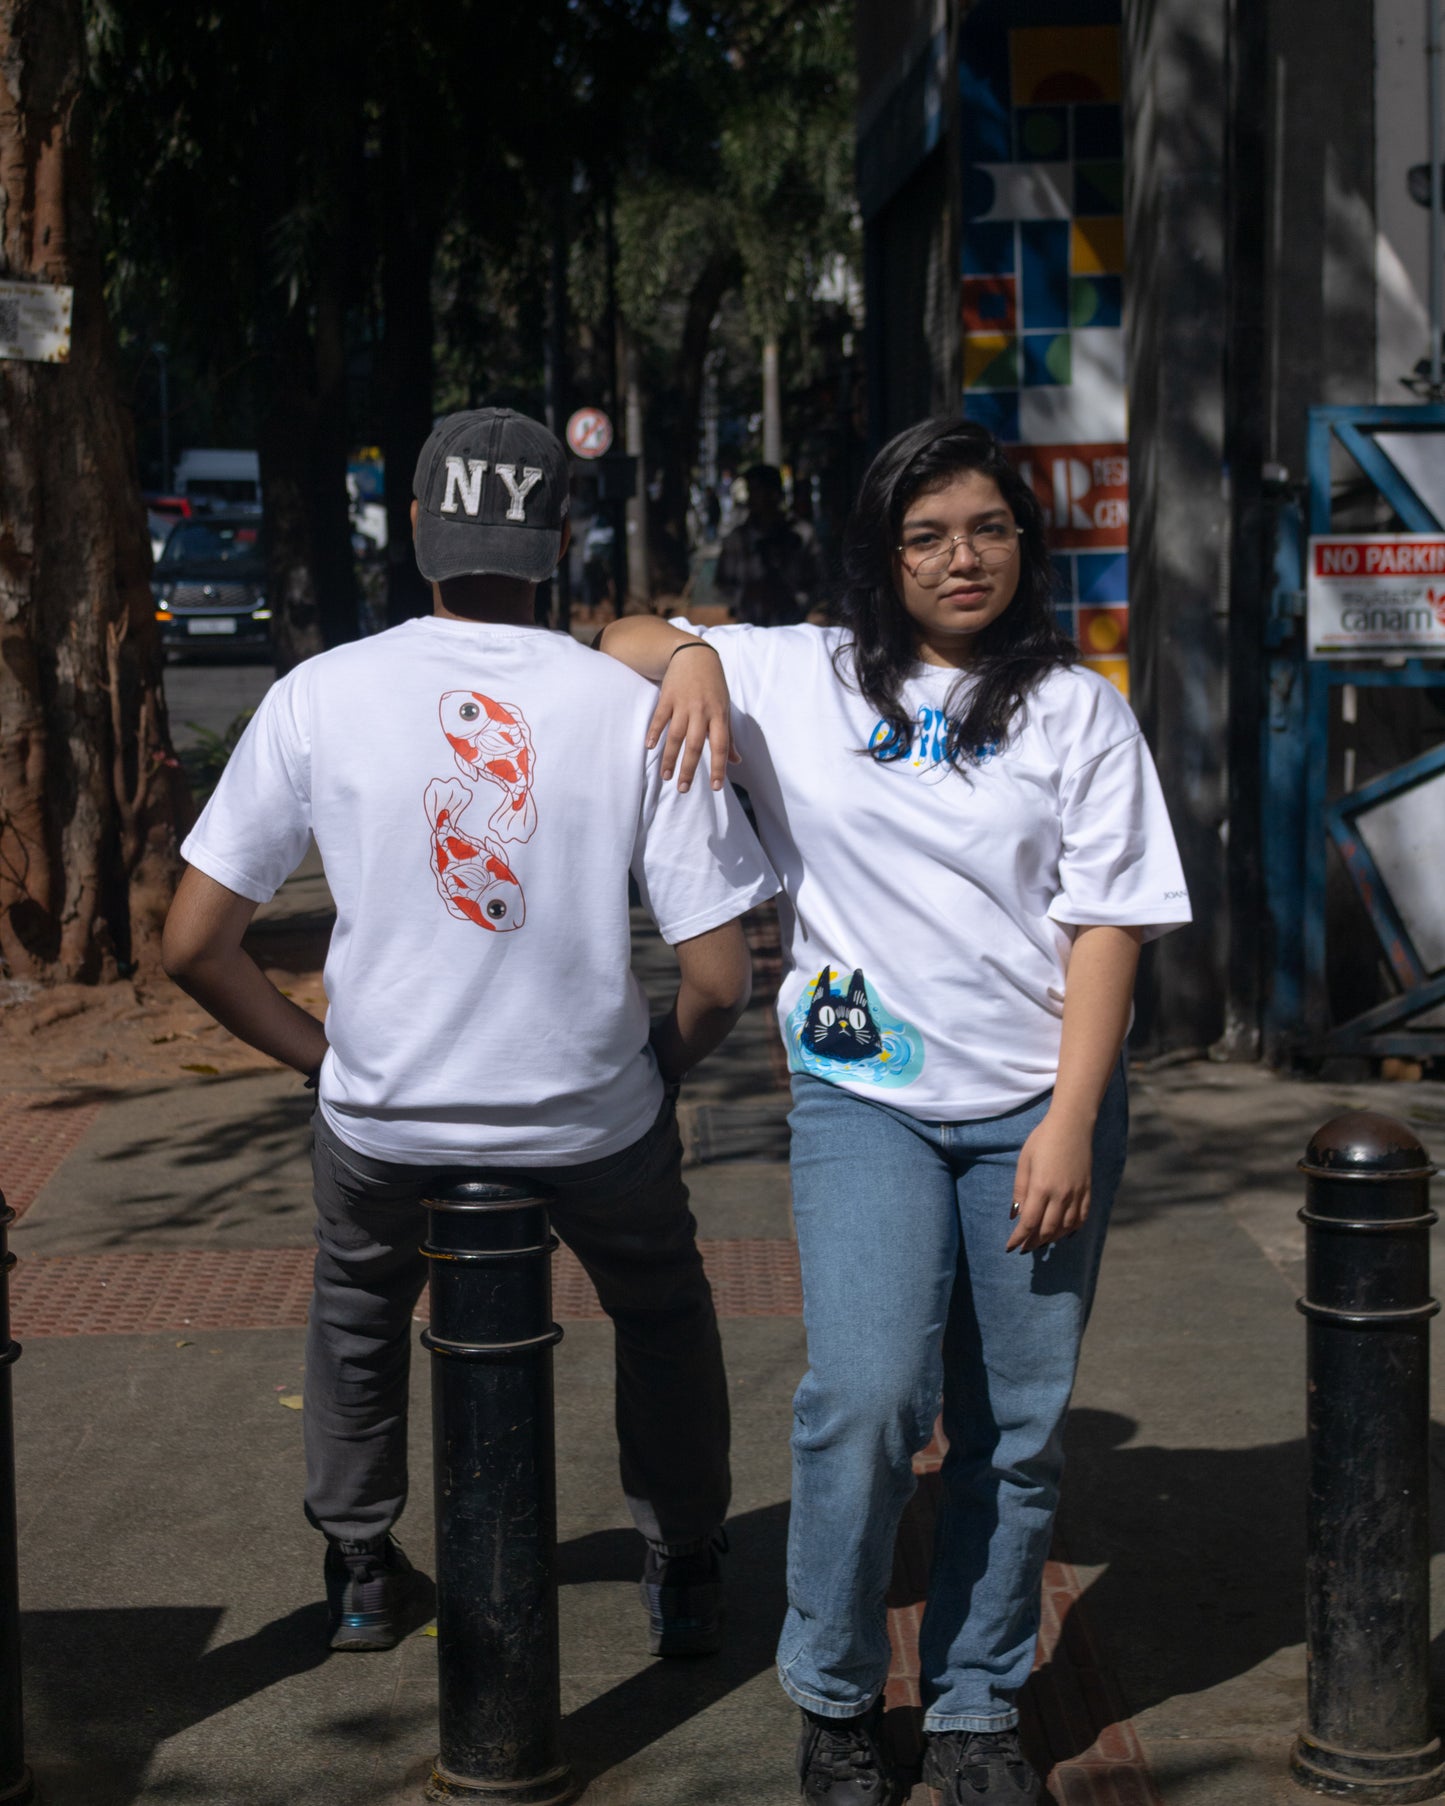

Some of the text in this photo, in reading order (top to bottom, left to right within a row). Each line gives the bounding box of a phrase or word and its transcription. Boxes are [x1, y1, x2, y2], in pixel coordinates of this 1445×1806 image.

[442, 456, 542, 521] NY
[1323, 547, 1359, 573] NO
[1341, 608, 1432, 632] canam
